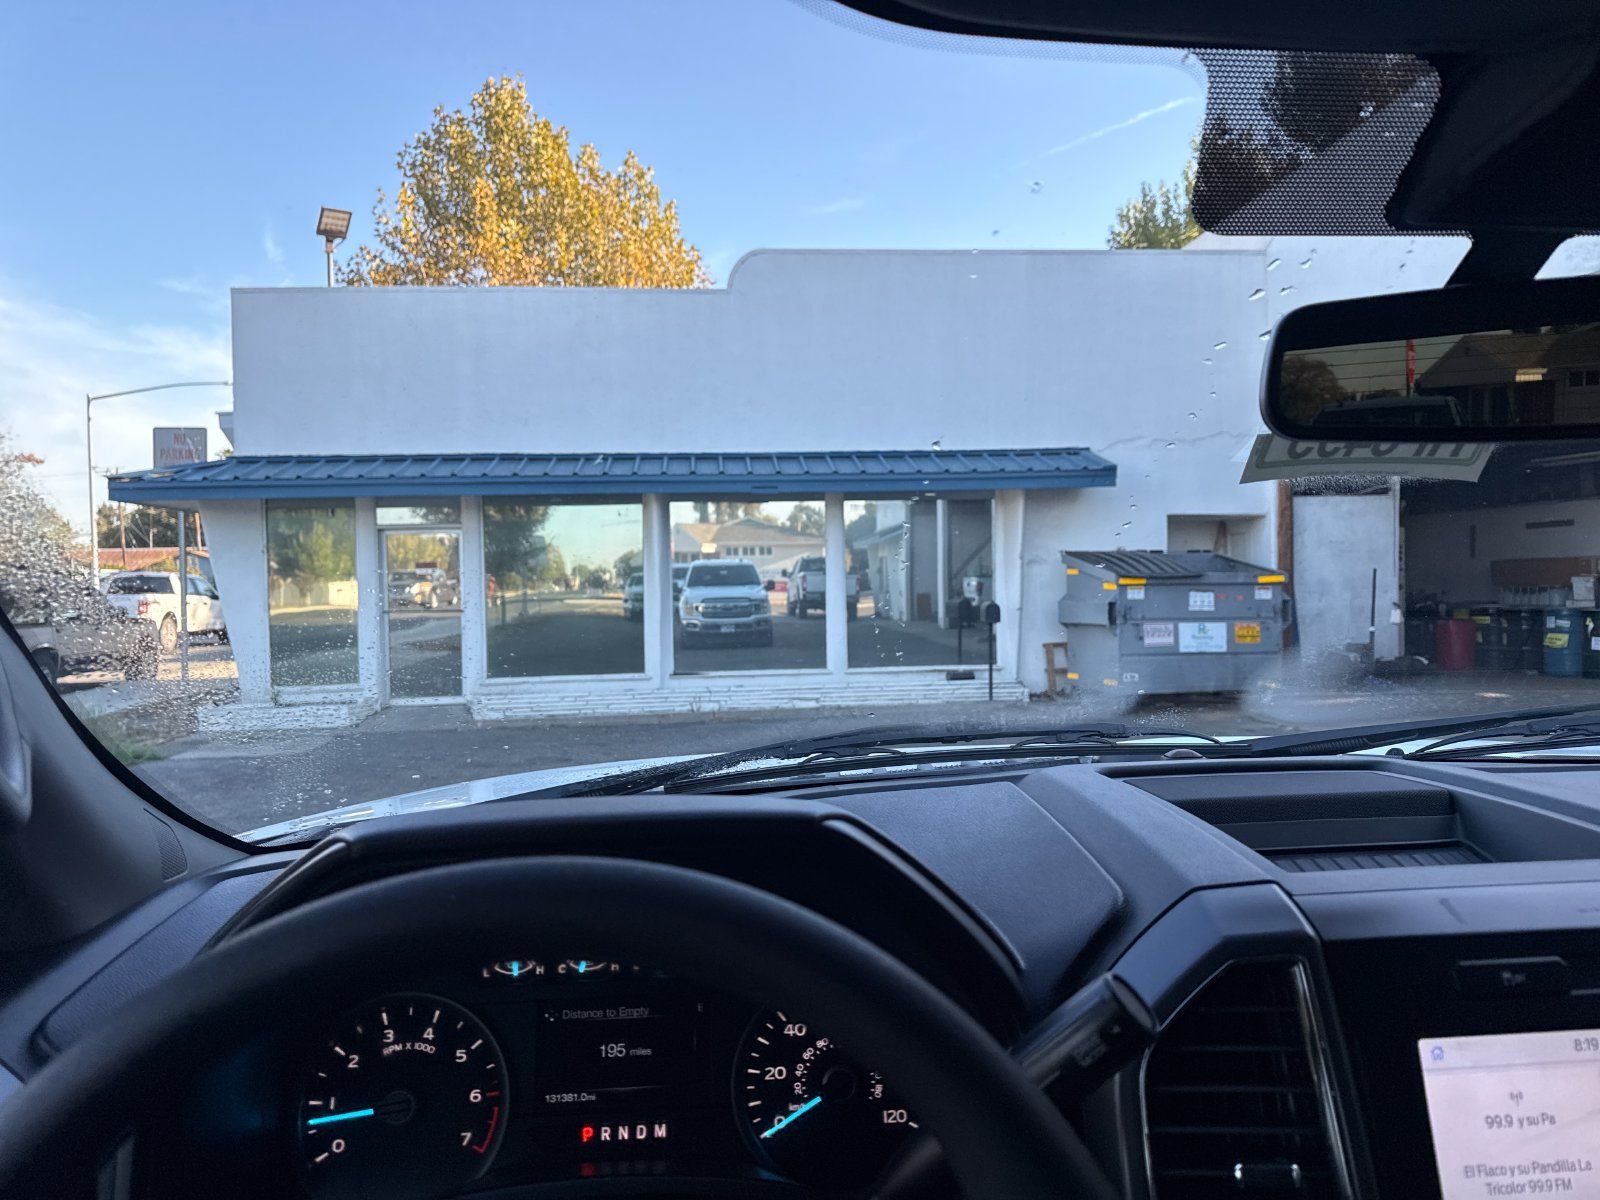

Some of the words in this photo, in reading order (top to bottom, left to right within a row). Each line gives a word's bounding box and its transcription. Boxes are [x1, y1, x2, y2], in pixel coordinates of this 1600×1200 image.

[173, 432, 186, 445] NO
[160, 448, 200, 460] PARKING
[562, 1009, 603, 1020] Distance
[606, 1008, 616, 1017] to
[619, 1006, 650, 1017] Empty
[383, 1029, 394, 1043] 3
[423, 1028, 434, 1040] 4
[783, 1023, 807, 1036] 40
[383, 1042, 403, 1056] RPM
[414, 1042, 436, 1054] 1000
[816, 1038, 829, 1048] 80
[1573, 1037, 1600, 1052] 8:19
[455, 1050, 467, 1063] 5
[600, 1043, 626, 1058] 195
[629, 1048, 652, 1056] miles
[802, 1047, 814, 1060] 60
[348, 1055, 359, 1068] 2
[764, 1066, 787, 1080] 20
[795, 1063, 804, 1077] 40
[469, 1089, 482, 1102] 6
[883, 1109, 908, 1124] 120
[1485, 1114, 1513, 1129] 99.9
[1518, 1117, 1525, 1129] y
[1527, 1116, 1540, 1126] su
[1541, 1112, 1556, 1126] Pa
[460, 1132, 472, 1146] 7
[582, 1126, 594, 1142] P
[601, 1126, 611, 1141] R
[618, 1125, 629, 1140] N
[636, 1125, 647, 1139] D
[654, 1123, 667, 1138] M
[332, 1139, 345, 1153] 0
[1464, 1165, 1475, 1179] El
[1478, 1164, 1507, 1177] Flaco
[1508, 1165, 1516, 1177] y
[1517, 1165, 1530, 1176] su
[1532, 1159, 1576, 1175] Pandilla
[1578, 1158, 1593, 1172] La
[1486, 1180, 1528, 1196] Tricolor
[1529, 1179, 1553, 1194] 99.9
[1555, 1178, 1573, 1191] FM
